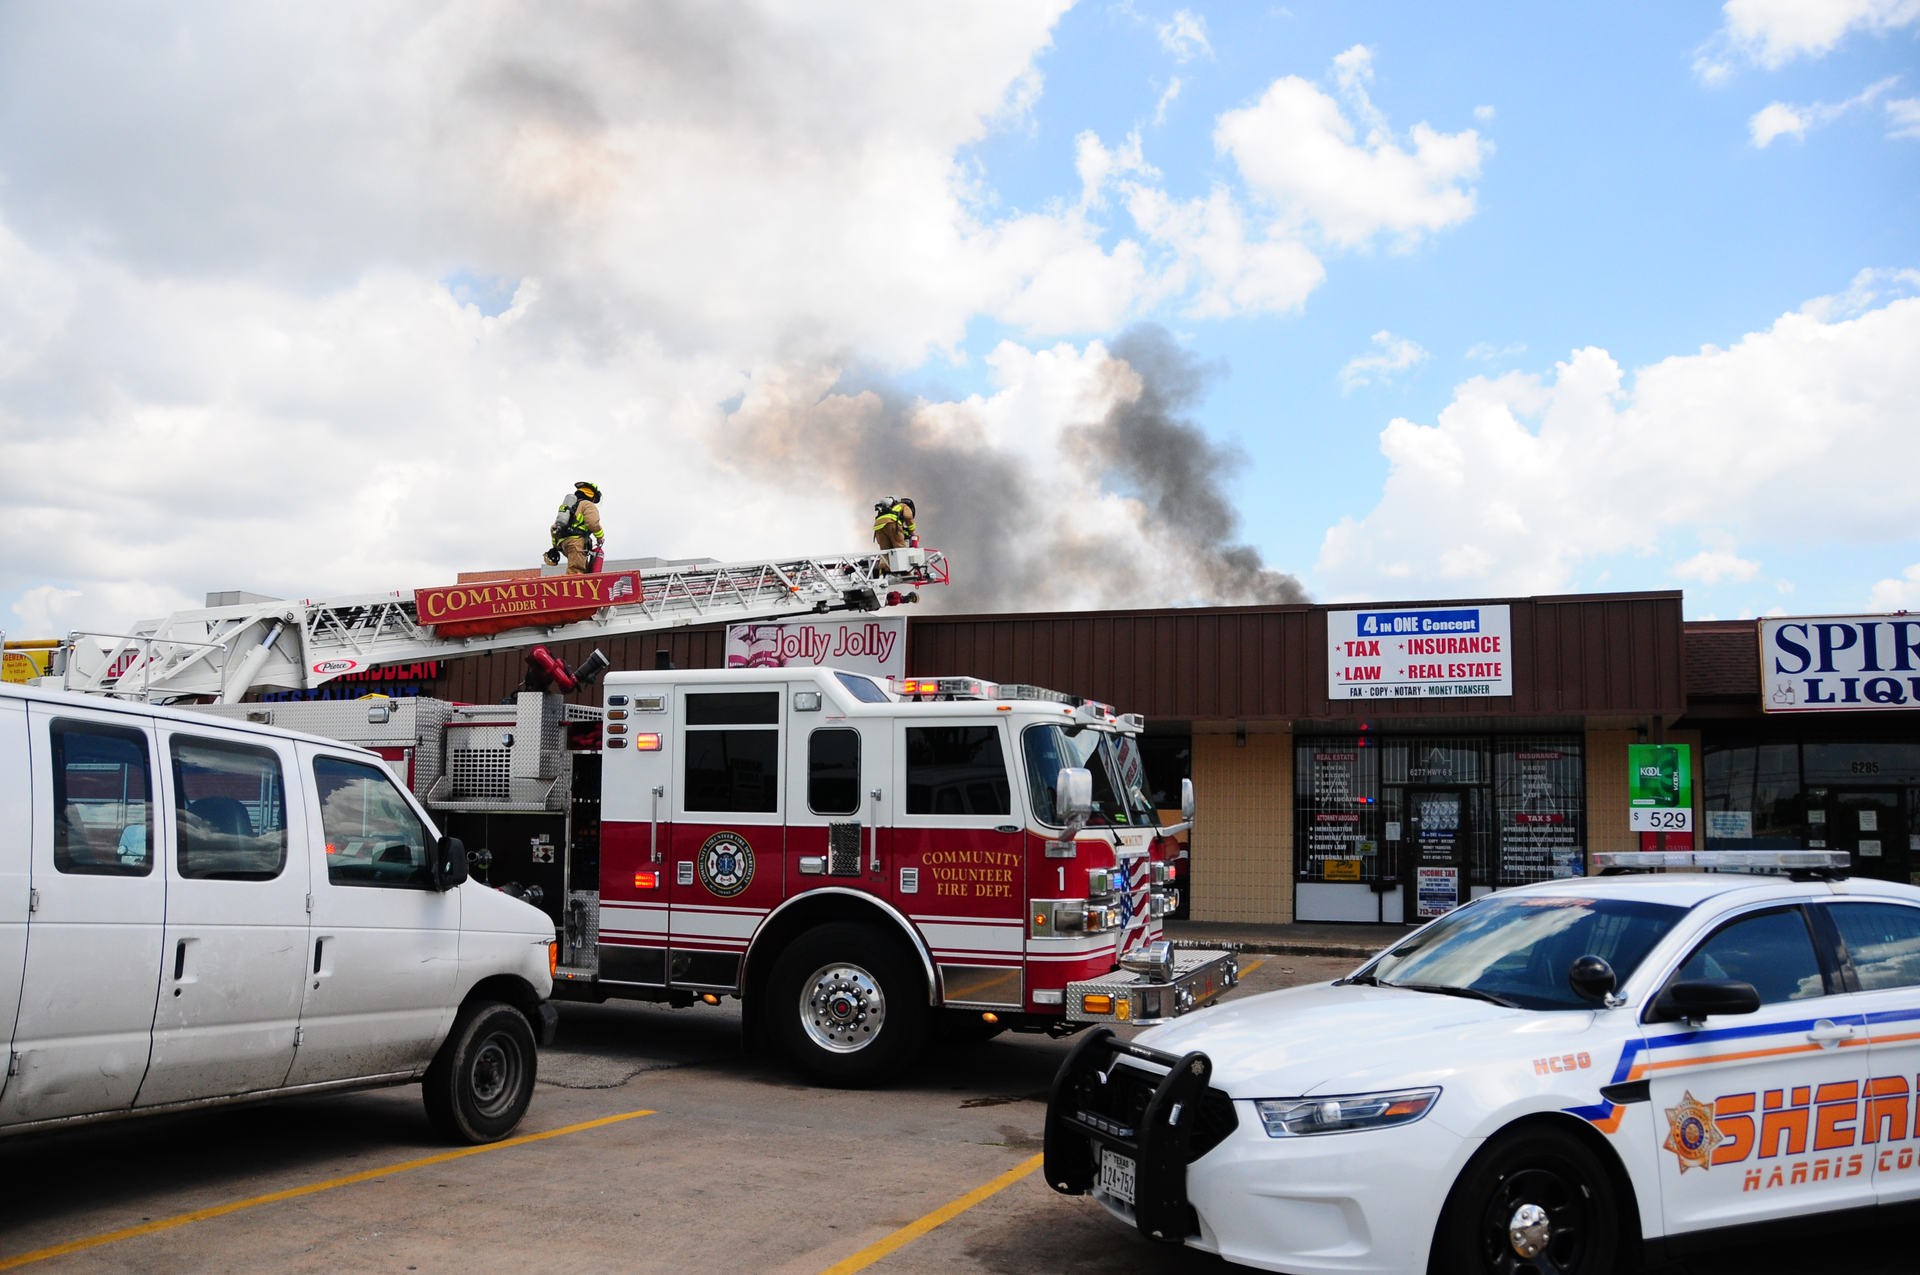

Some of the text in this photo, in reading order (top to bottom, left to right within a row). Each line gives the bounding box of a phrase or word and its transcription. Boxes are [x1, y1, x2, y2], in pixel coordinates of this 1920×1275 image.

[427, 578, 602, 617] COMMUNITY
[492, 598, 547, 614] LADDER 1
[1364, 616, 1476, 633] 4 IN ONE Concept
[771, 623, 896, 665] Jolly Jolly
[1344, 640, 1381, 657] TAX
[1408, 636, 1501, 655] INSURANCE
[1775, 621, 1920, 674] SPIR
[322, 662, 348, 671] Pierce
[329, 660, 437, 682] IBBEAN
[1345, 666, 1381, 681] LAW
[1408, 662, 1502, 679] REAL ESTATE
[263, 686, 419, 702] RESTAURNT
[1350, 684, 1490, 697] FAX COPY NOTARY MONEY TRANSFER
[1410, 768, 1426, 776] 6277
[1428, 768, 1441, 776] HWY
[1640, 767, 1662, 776] KOOL
[1851, 761, 1879, 773] 6285
[1634, 811, 1639, 820] $
[922, 851, 1022, 867] COMMUNITY
[932, 868, 1013, 882] VOLUNTEER
[1057, 866, 1065, 891] 1
[937, 883, 1012, 898] FIRE DEPT.
[1172, 940, 1244, 950] PARKING ONLY
[1533, 1052, 1591, 1075] HCSO
[1114, 1155, 1129, 1168] TEXAS
[1743, 1147, 1920, 1192] HARRIS CO
